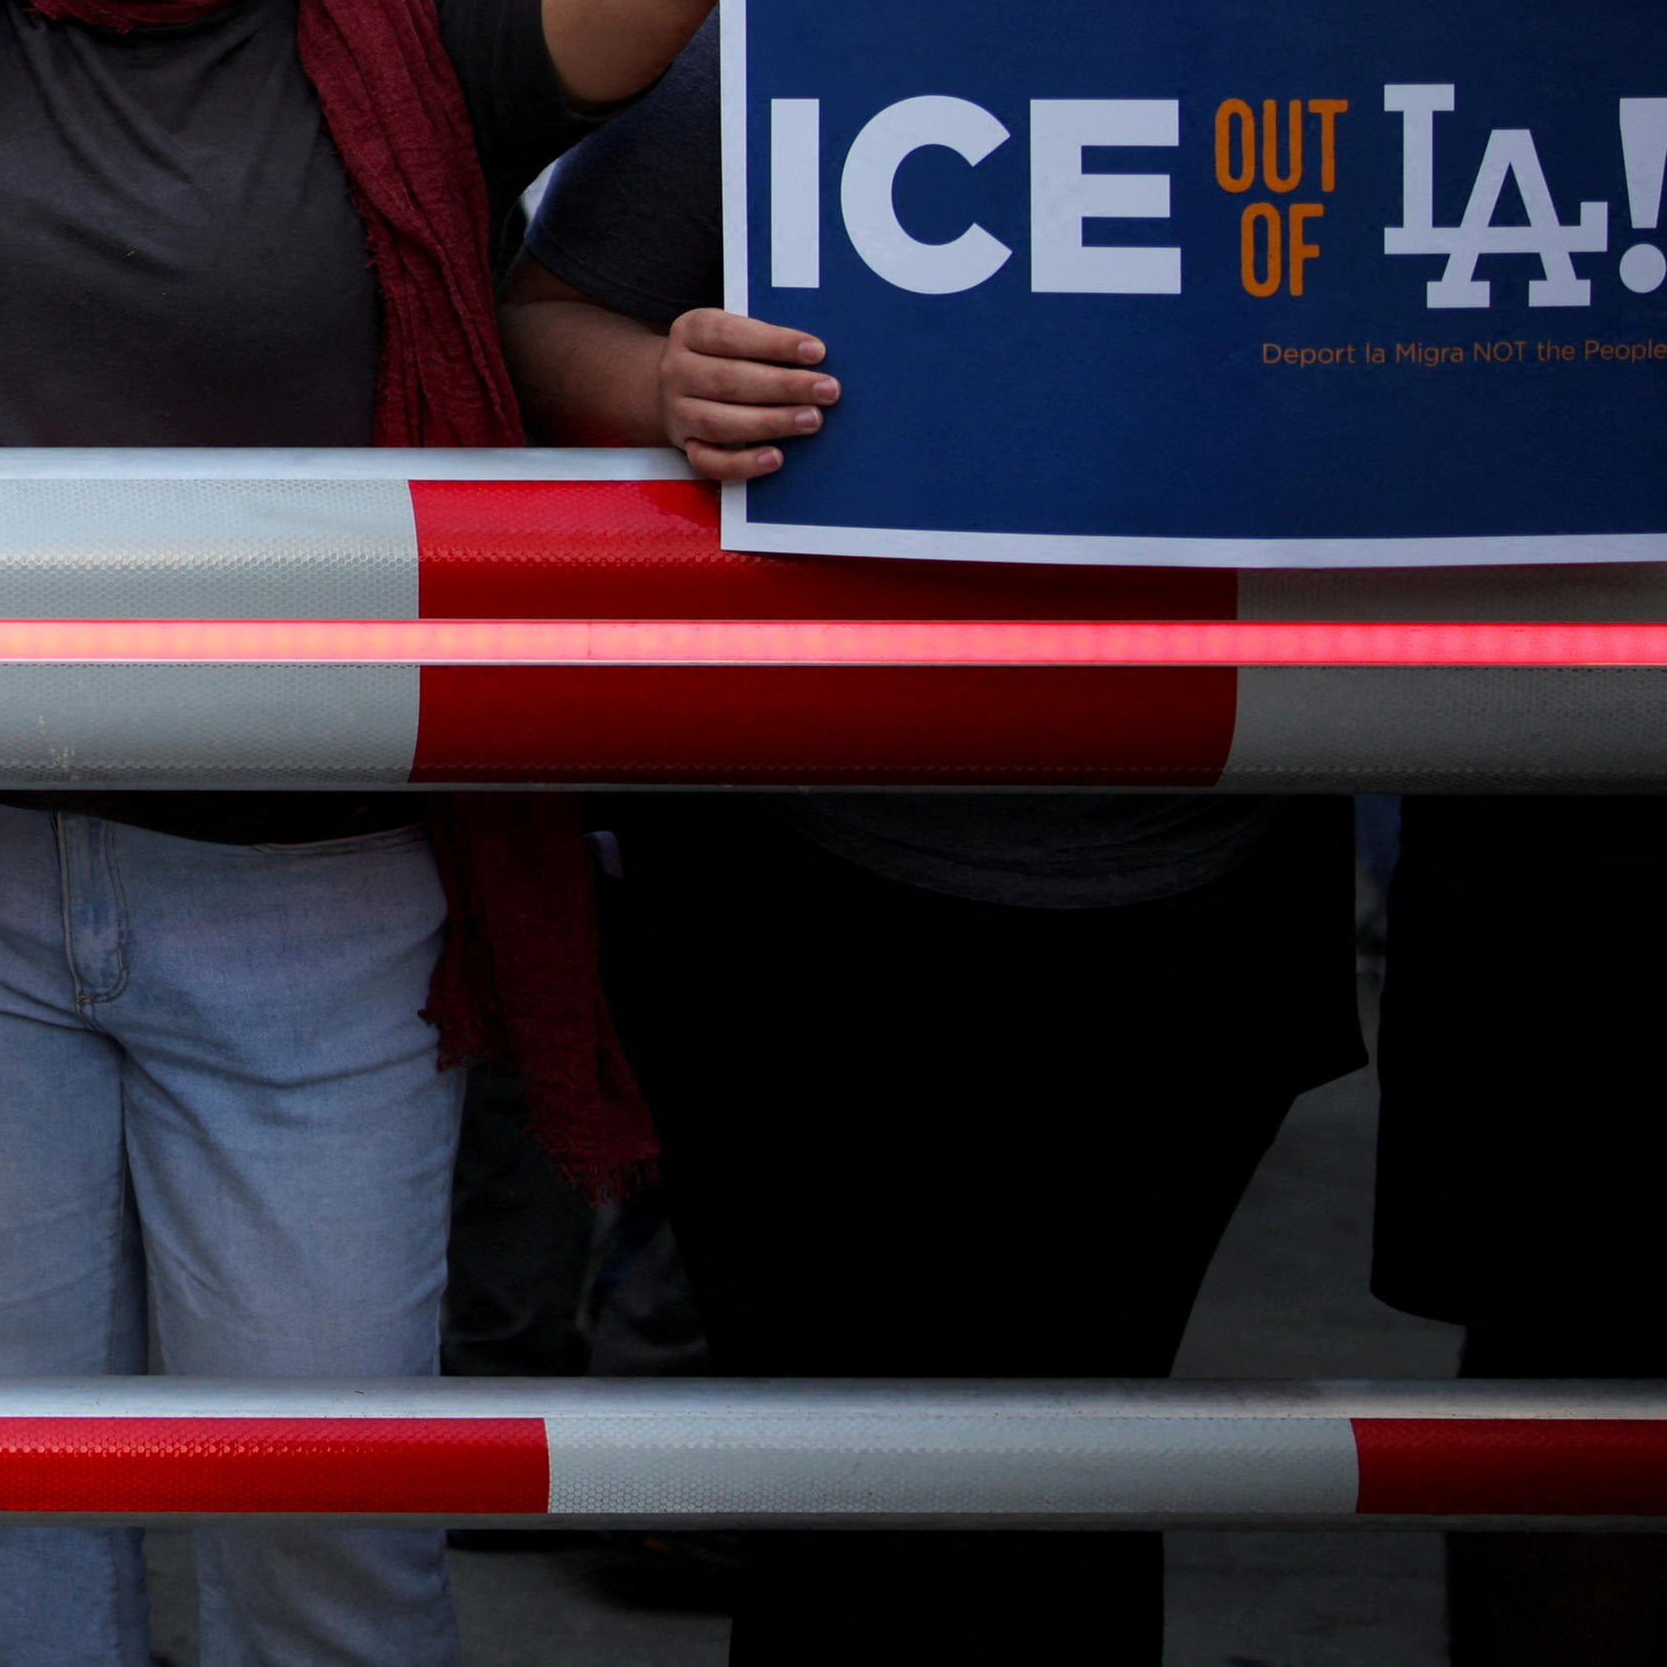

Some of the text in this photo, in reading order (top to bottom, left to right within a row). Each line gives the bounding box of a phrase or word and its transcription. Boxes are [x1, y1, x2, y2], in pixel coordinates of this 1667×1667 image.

[1214, 97, 1351, 195] OUT
[770, 95, 1183, 295] ICE
[1240, 201, 1327, 298] OF
[1262, 338, 1667, 368] Deport la Migra NOT the People
